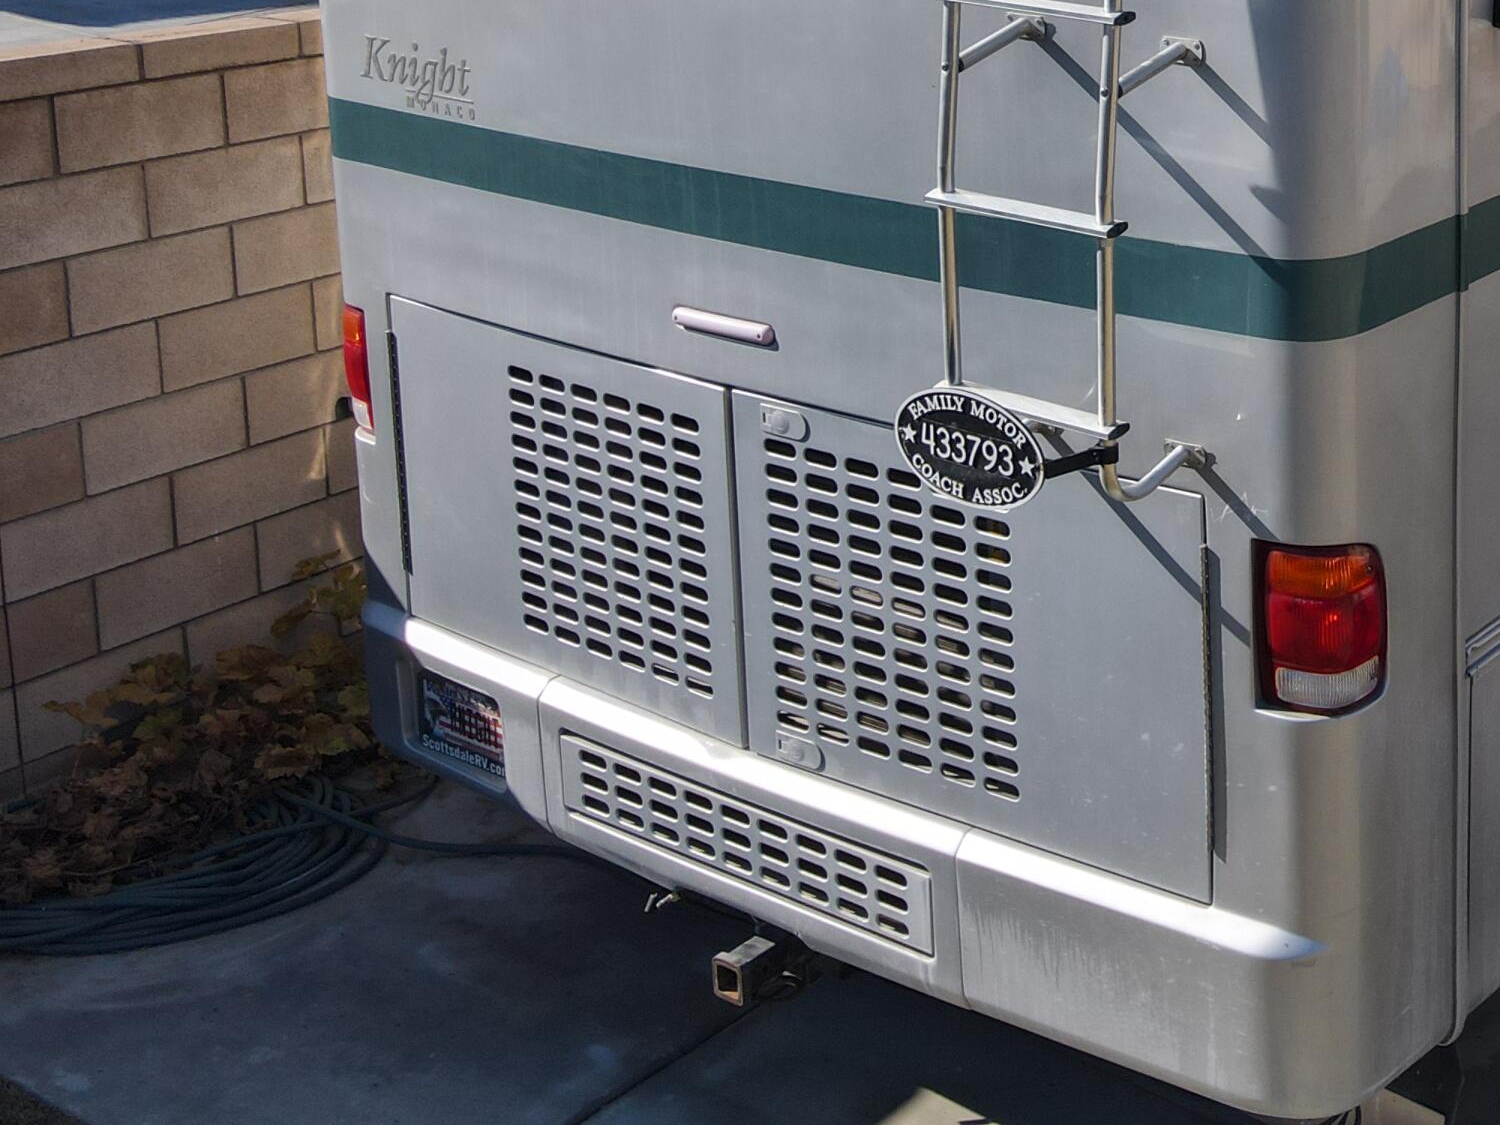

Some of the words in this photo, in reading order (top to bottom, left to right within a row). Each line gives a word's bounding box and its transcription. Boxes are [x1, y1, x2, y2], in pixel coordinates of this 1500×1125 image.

[360, 34, 471, 104] Knight
[406, 95, 476, 121] MONACO
[907, 394, 965, 420] FAMILY
[969, 400, 1027, 449] MOTOR
[920, 422, 1015, 476] 433793
[912, 453, 965, 498] COACH
[972, 481, 1028, 505] ASSOC.
